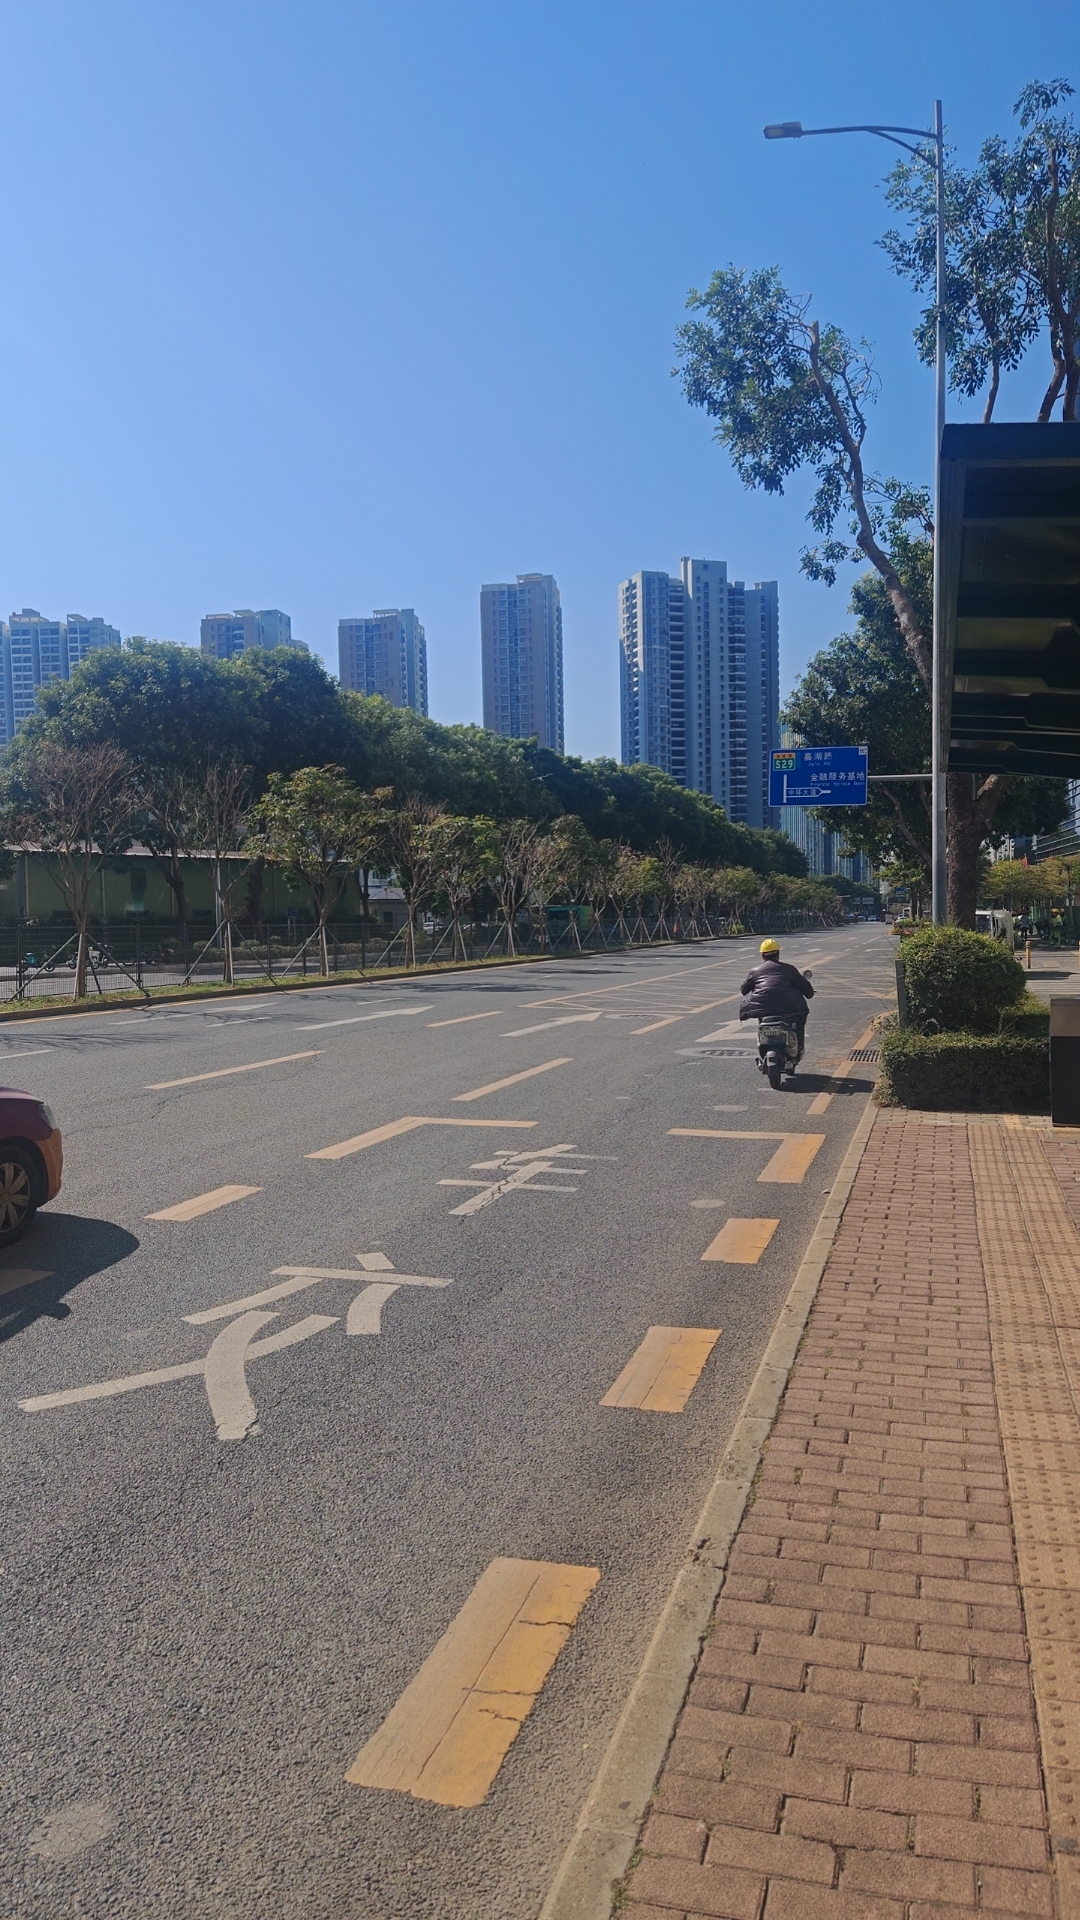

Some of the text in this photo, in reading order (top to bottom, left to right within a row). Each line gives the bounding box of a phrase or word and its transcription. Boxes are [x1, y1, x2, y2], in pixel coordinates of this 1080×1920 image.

[775, 759, 793, 769] S29
[810, 771, 865, 782] 金融服务基地
